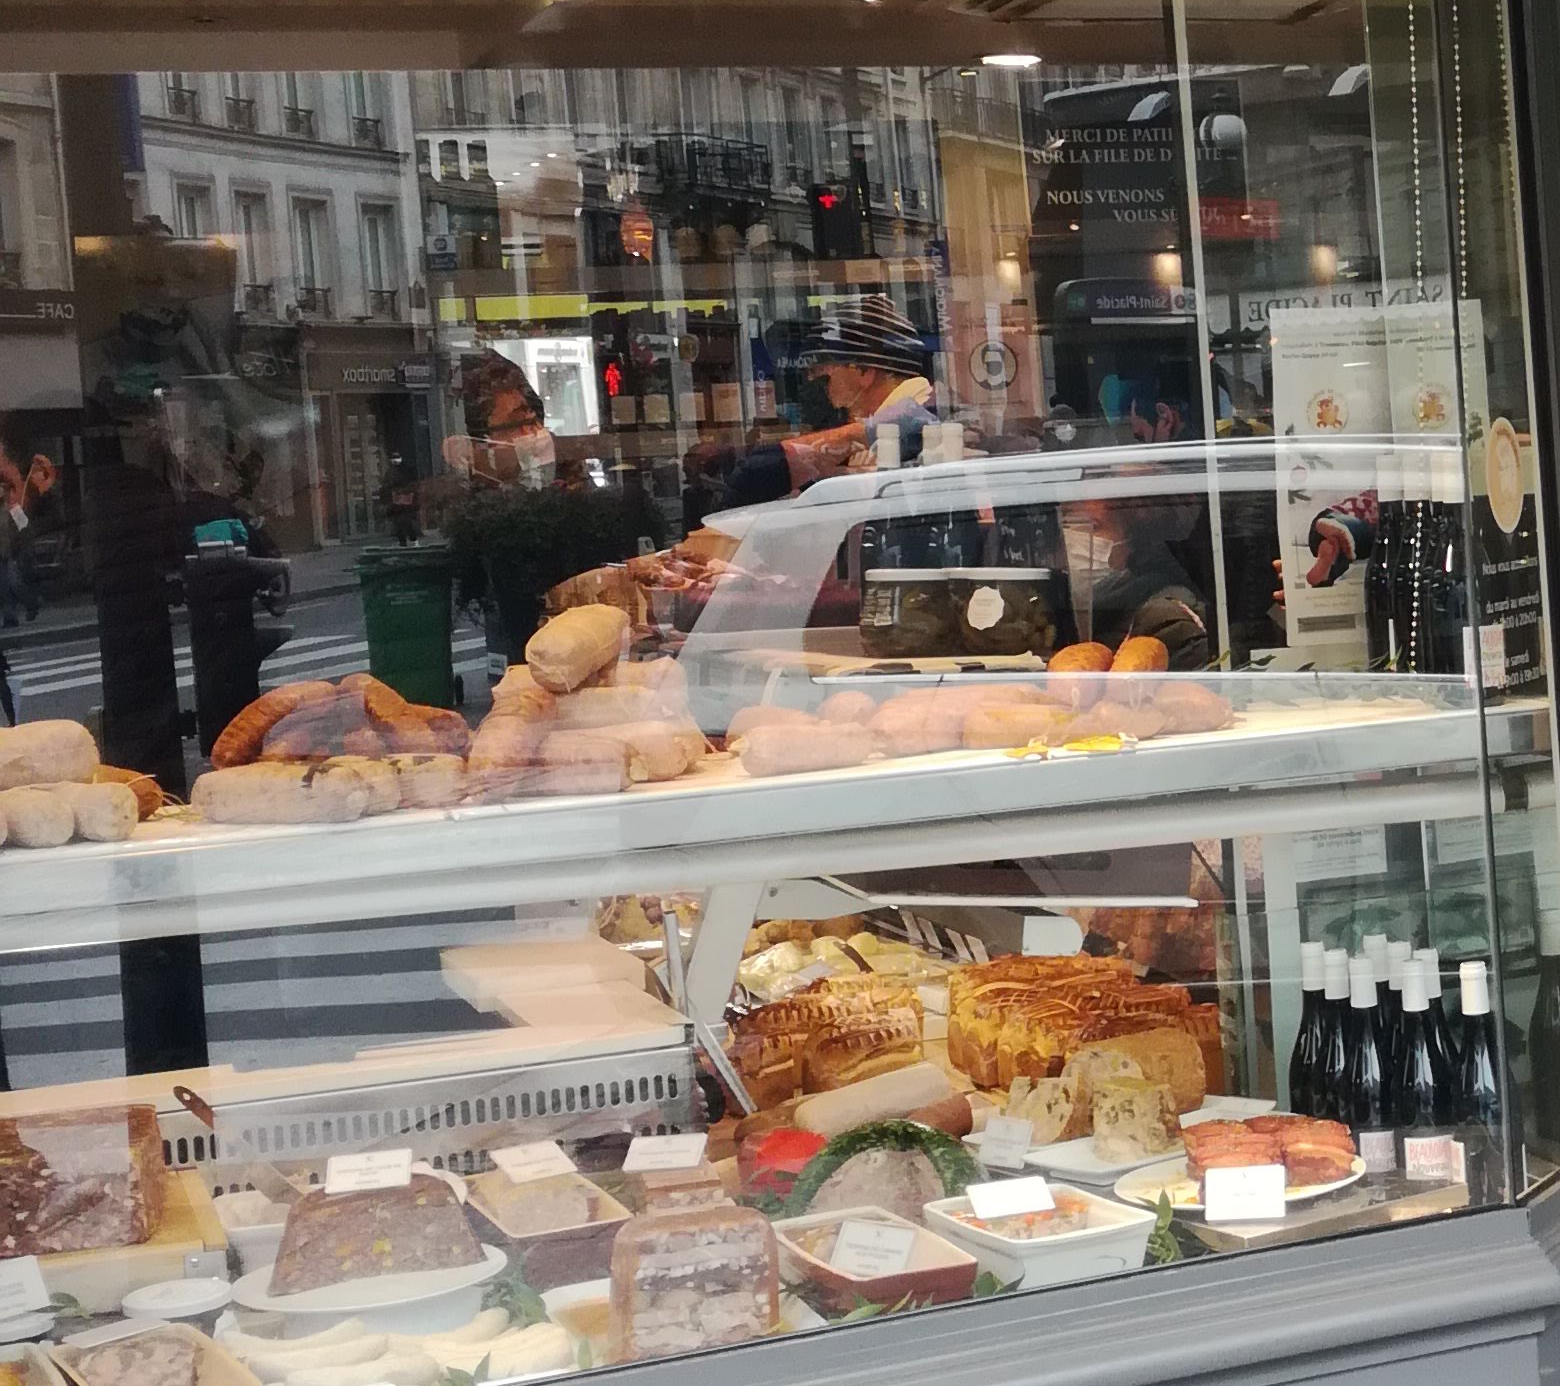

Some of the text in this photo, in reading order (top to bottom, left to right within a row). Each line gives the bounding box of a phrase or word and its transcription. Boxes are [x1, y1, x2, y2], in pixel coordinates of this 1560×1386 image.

[1046, 128, 1101, 143] MERCI
[1106, 128, 1129, 143] DE
[1032, 146, 1222, 163] SUR LA FILE DE DITE
[1047, 187, 1164, 205] NOUS VENONS
[1113, 209, 1157, 223] VOUS
